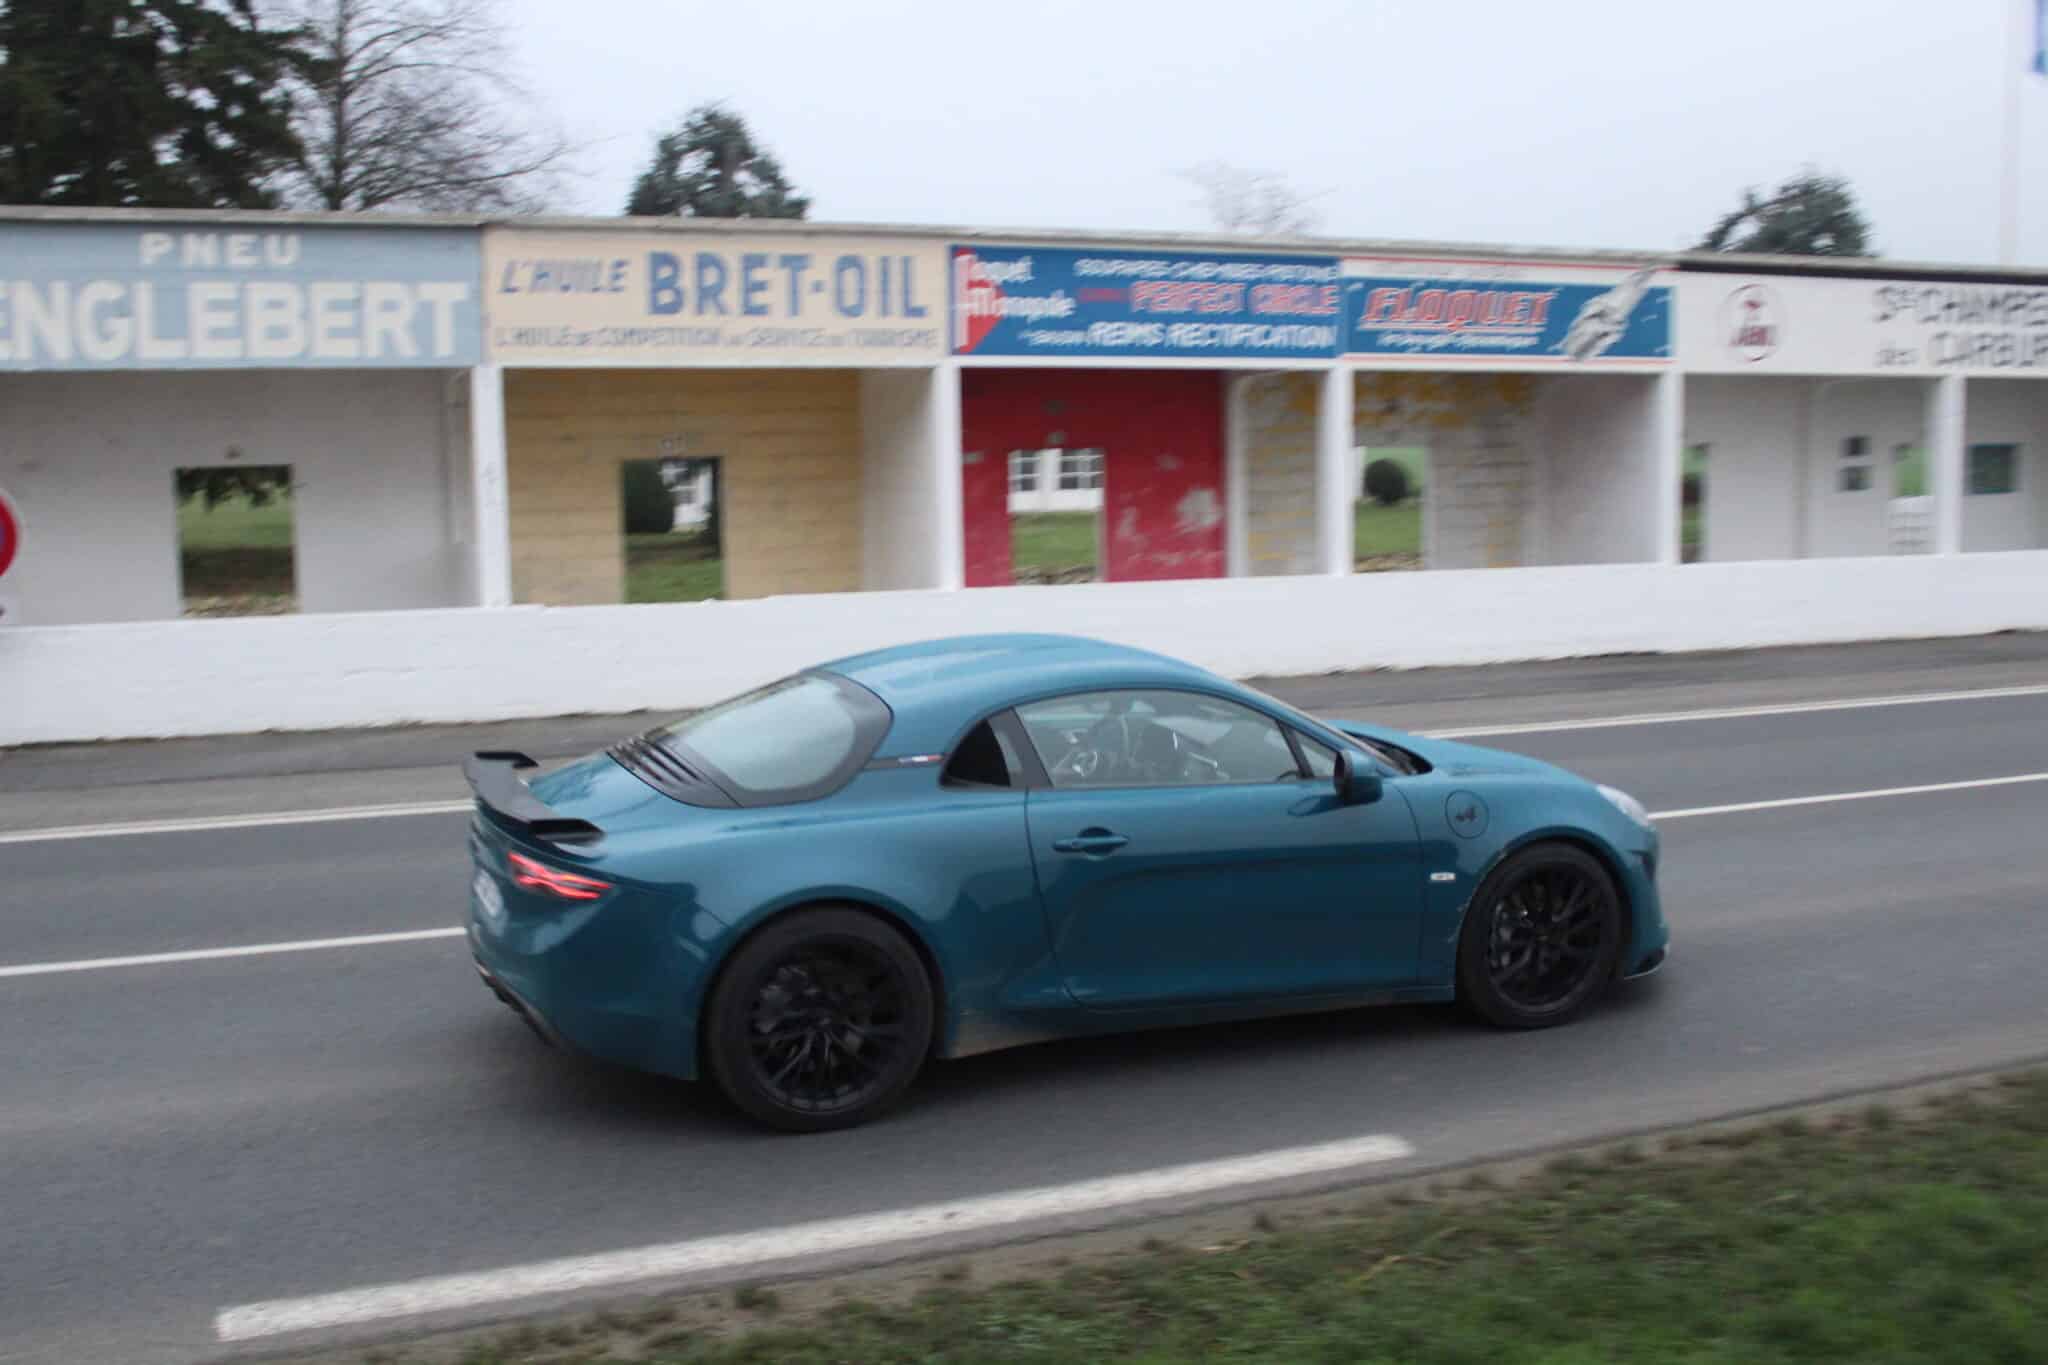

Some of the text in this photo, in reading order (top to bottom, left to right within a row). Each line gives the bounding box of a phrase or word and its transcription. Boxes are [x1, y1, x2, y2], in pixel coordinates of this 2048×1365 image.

[139, 232, 300, 266] PNEU
[648, 251, 929, 318] BRET-OIL
[0, 279, 470, 361] NGLEBERT
